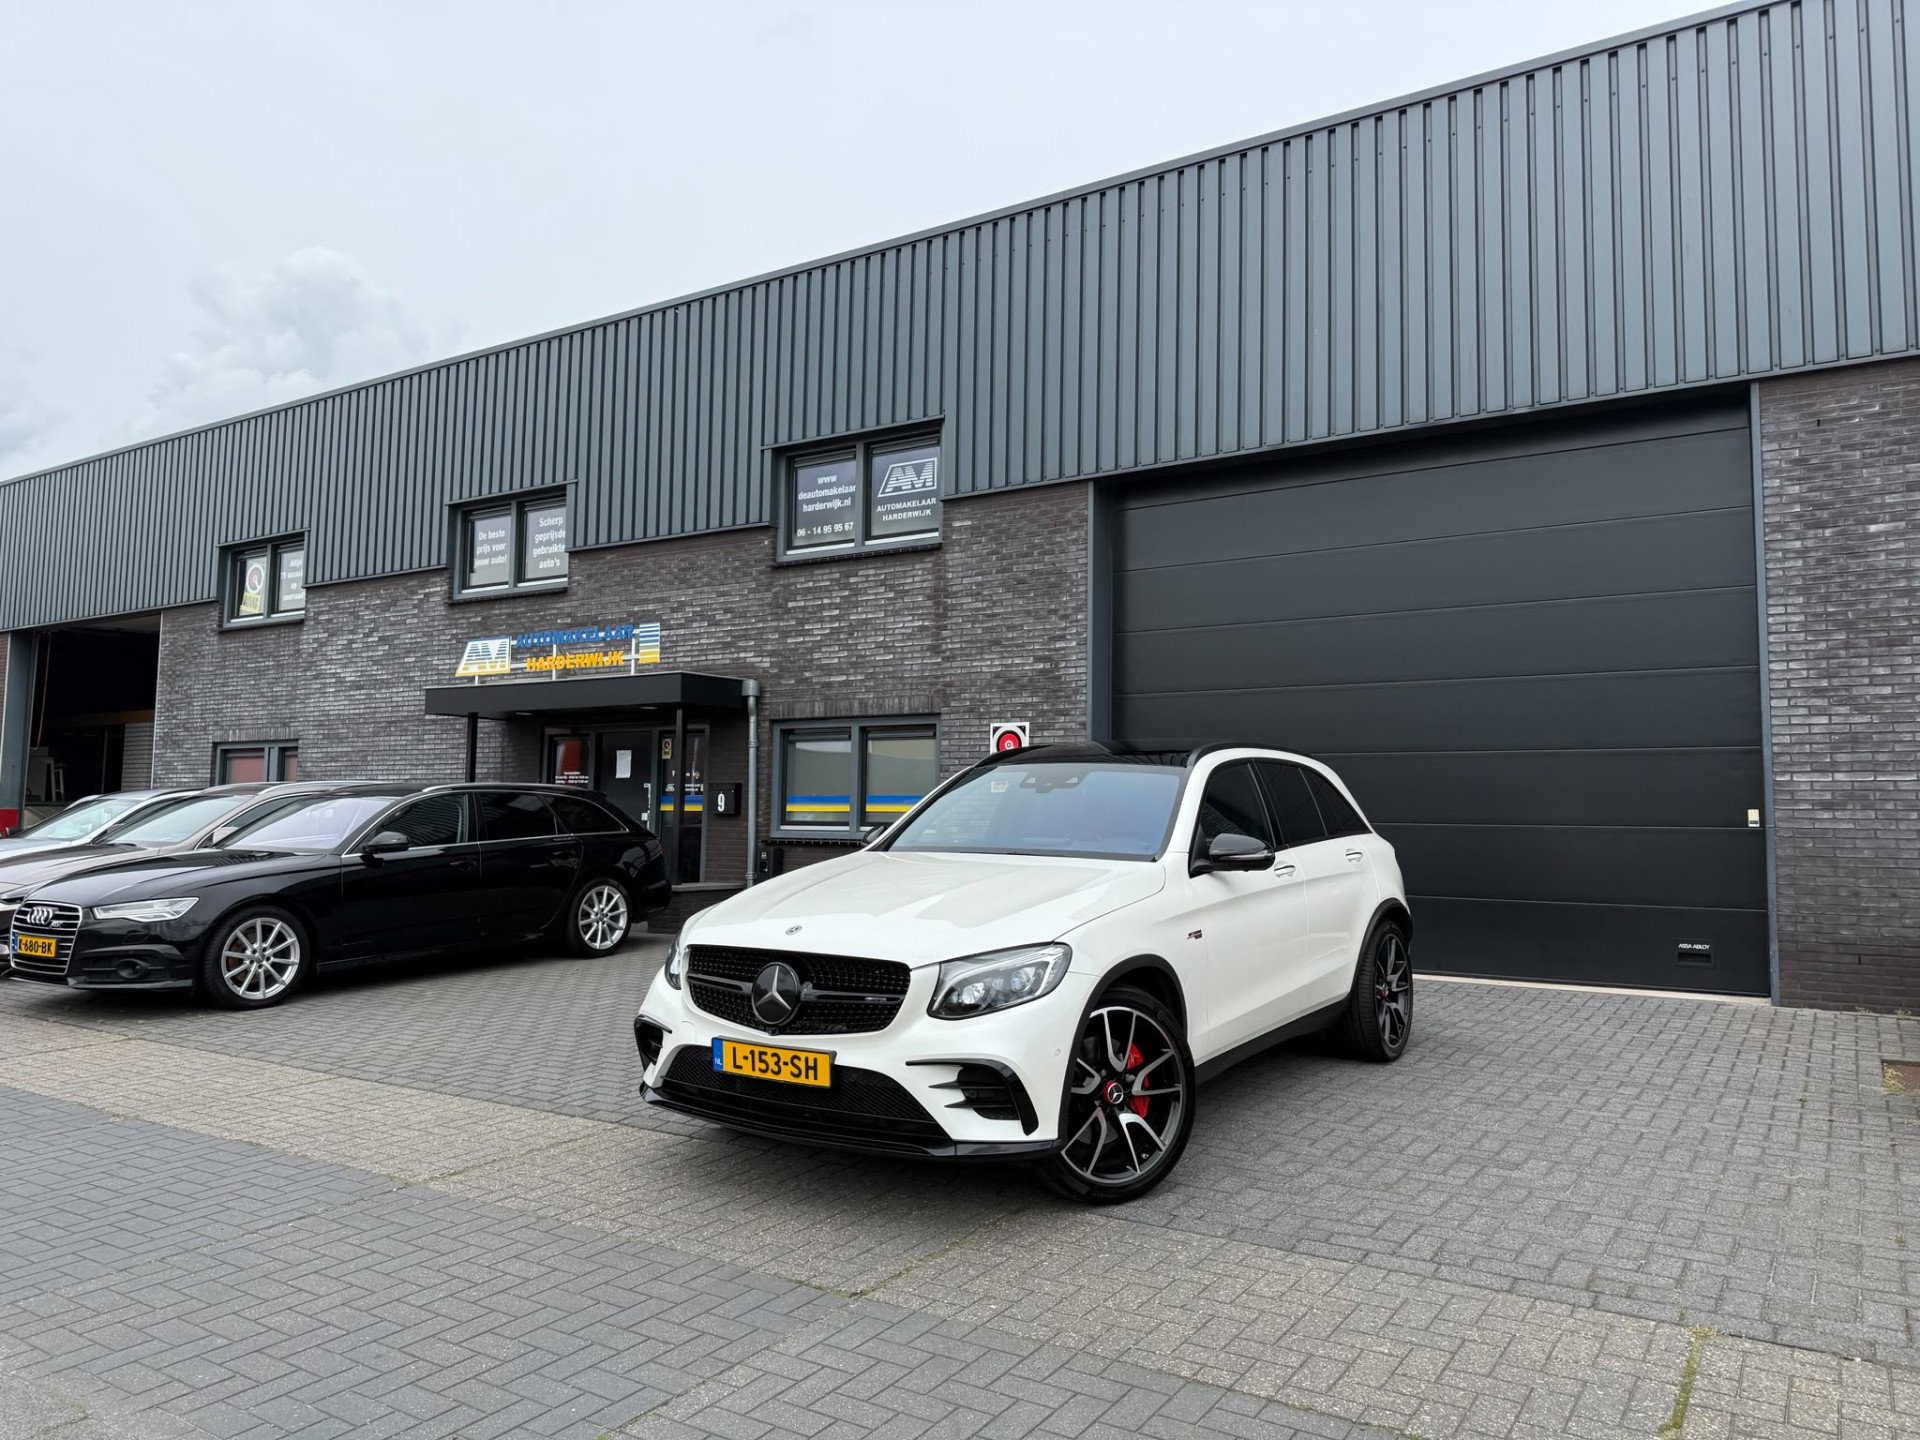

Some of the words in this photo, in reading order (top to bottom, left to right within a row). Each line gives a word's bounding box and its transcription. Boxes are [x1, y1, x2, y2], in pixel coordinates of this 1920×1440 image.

[816, 474, 838, 485] www
[798, 484, 857, 501] deautomakelaar
[802, 497, 852, 513] harderwijk.nl
[876, 497, 937, 512] AUTOMAKELAAR
[539, 516, 564, 527] Scherp
[882, 508, 932, 522] HARDERWIJK
[478, 531, 487, 540] De
[488, 529, 506, 539] beste
[796, 528, 806, 537] 06
[812, 525, 822, 535] 14
[823, 524, 832, 534] 95
[833, 523, 843, 532] 95
[476, 543, 491, 556] prijs
[492, 543, 507, 552] voor
[490, 553, 507, 565] auto!
[538, 557, 561, 569] auto's
[515, 624, 635, 648] AUTOMAKELAAR
[525, 651, 625, 672] HARDERWIJK
[717, 793, 726, 812] 9
[732, 1046, 818, 1081] L-153-SH
